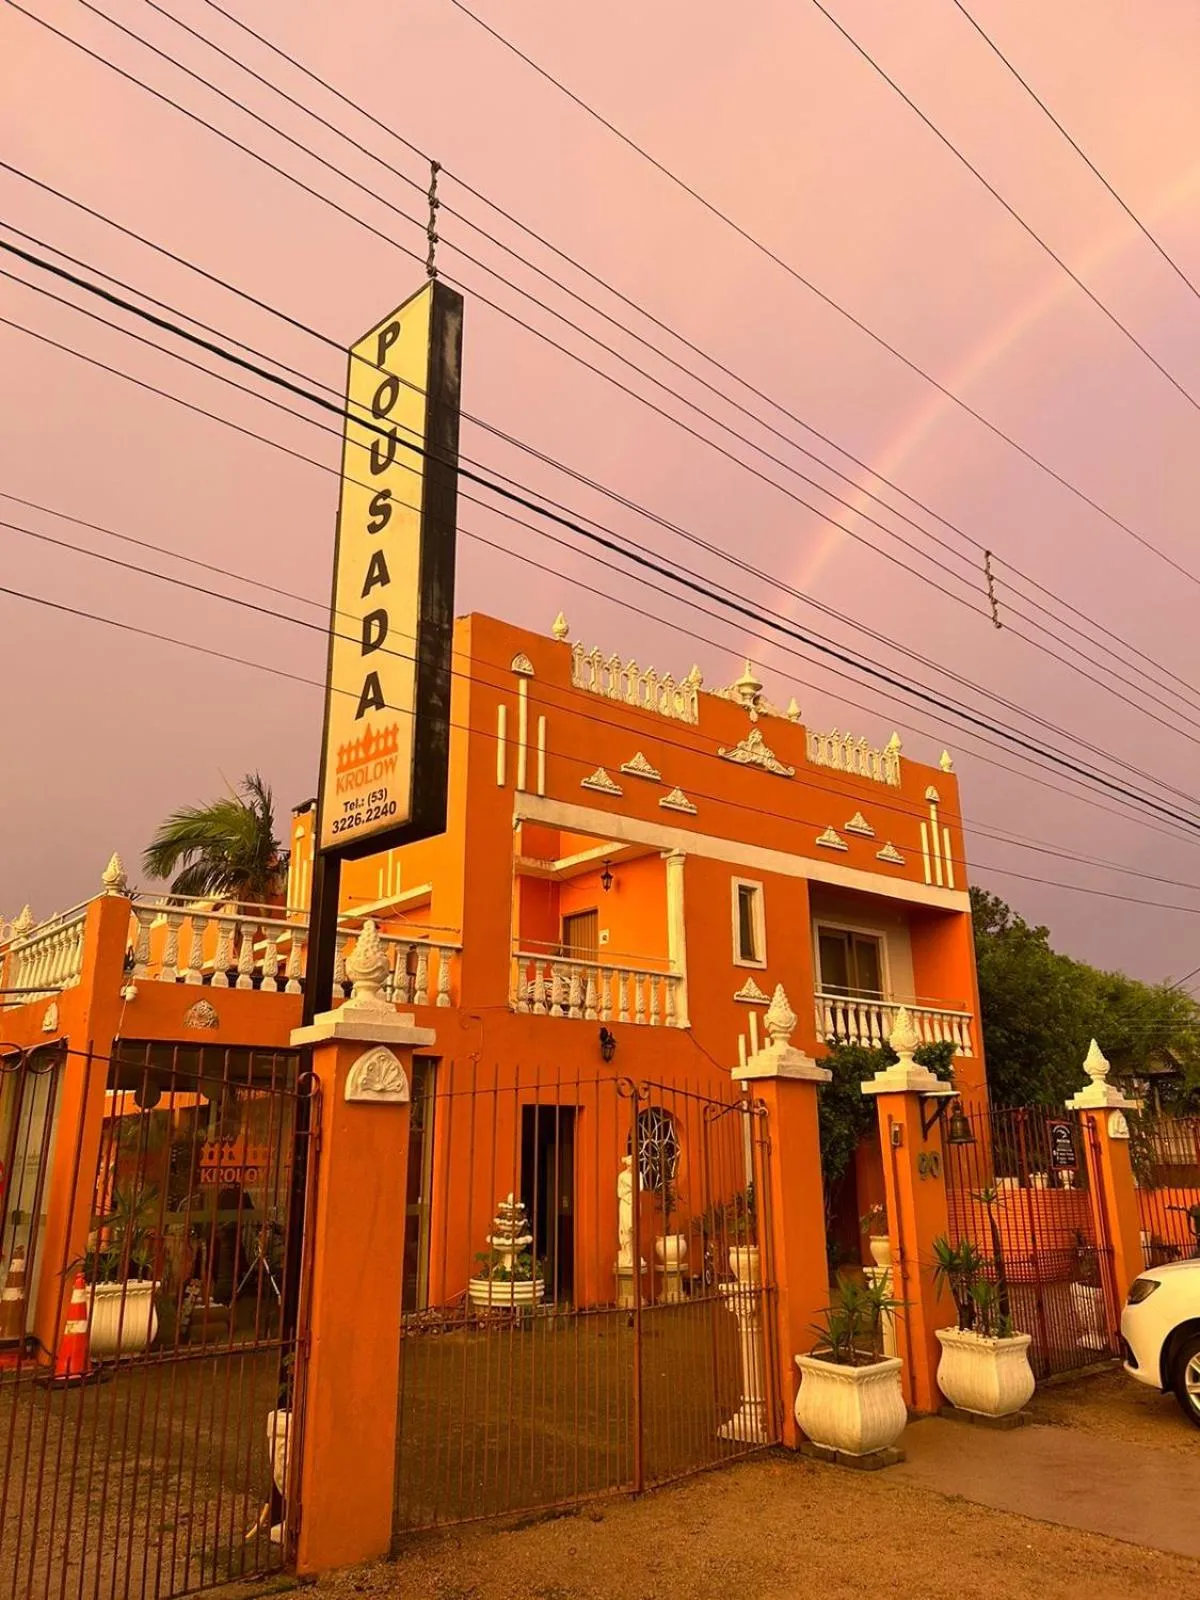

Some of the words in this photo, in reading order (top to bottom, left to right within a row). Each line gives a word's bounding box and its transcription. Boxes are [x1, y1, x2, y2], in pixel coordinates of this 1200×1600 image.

[355, 320, 401, 720] POUSADA
[336, 755, 398, 796] KROLOW
[332, 800, 397, 834] 3226.2240
[343, 798, 365, 813] Tel.:
[367, 787, 387, 807] (53)
